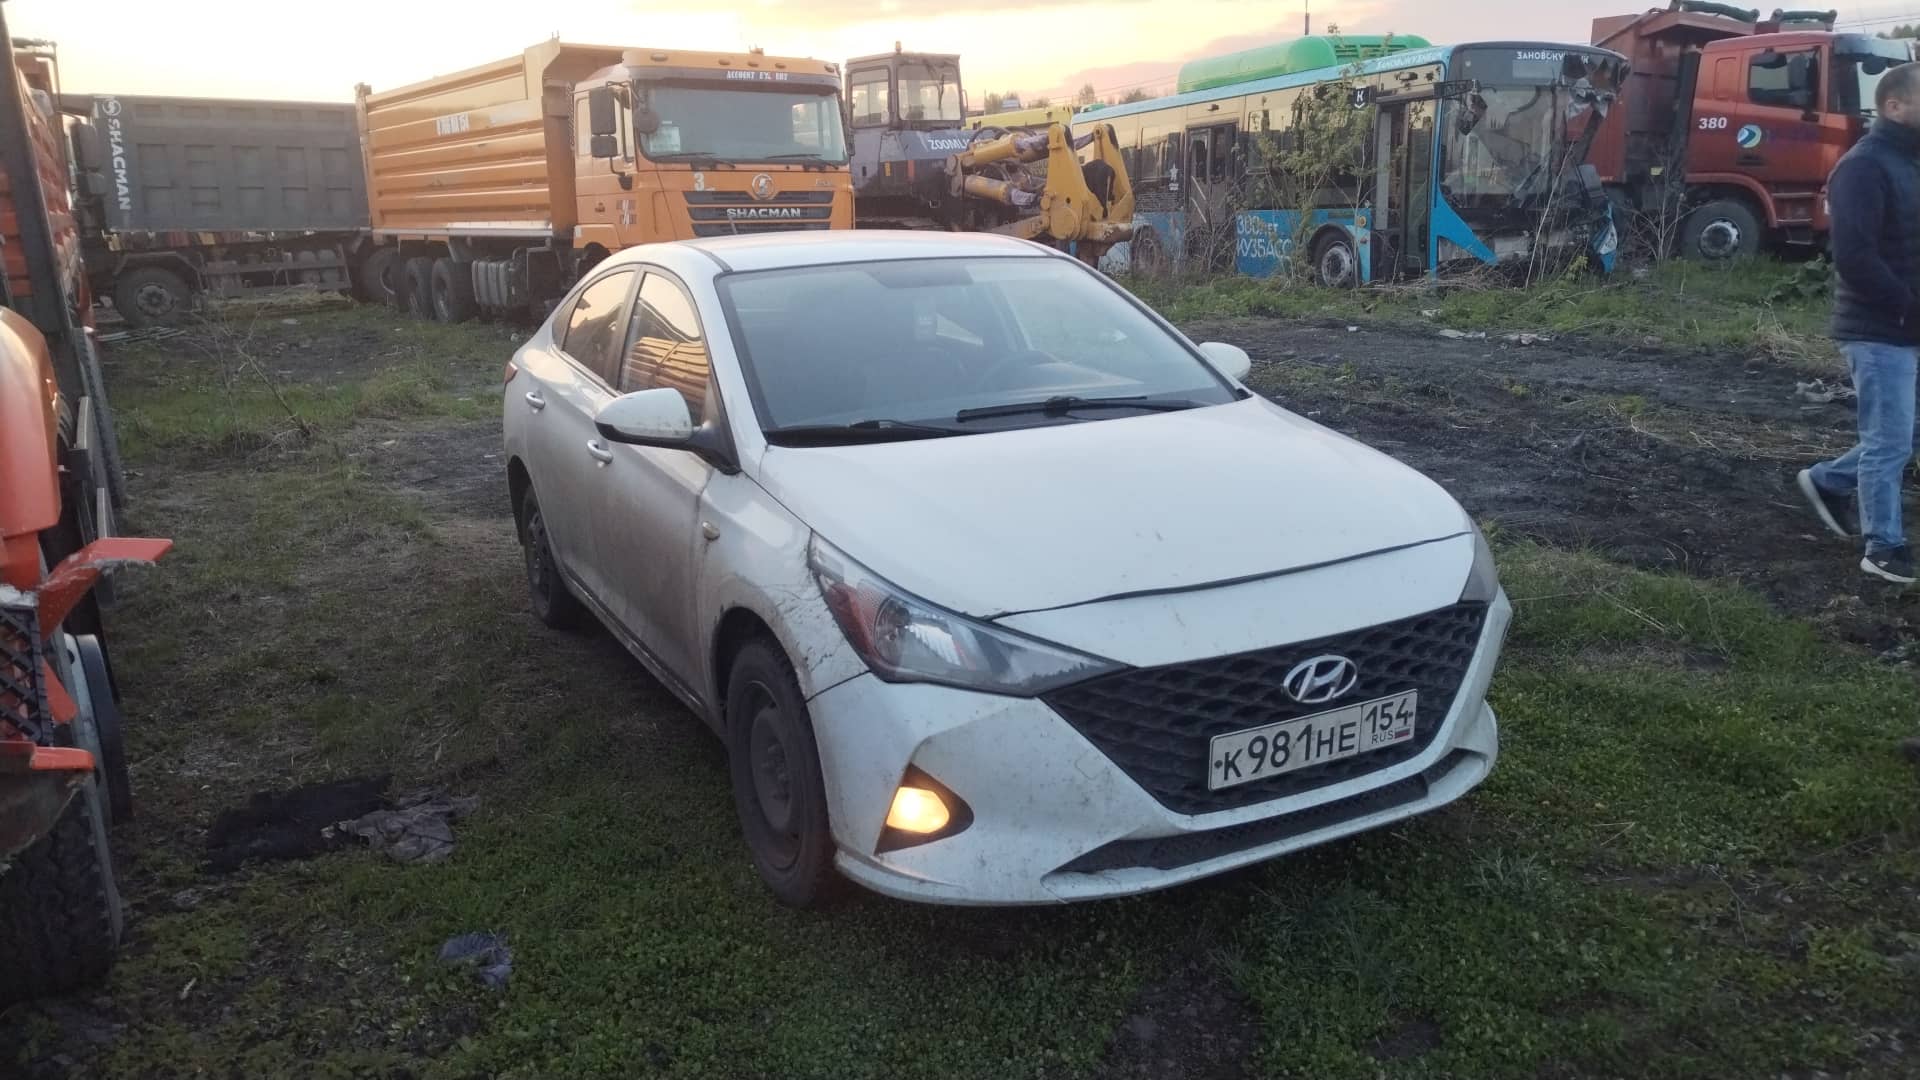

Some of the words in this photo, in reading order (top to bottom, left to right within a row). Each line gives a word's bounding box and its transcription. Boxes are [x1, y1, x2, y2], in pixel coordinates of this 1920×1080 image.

[1698, 117, 1728, 130] 380
[107, 118, 131, 210] SHACMAN
[727, 207, 801, 218] SHACMAN
[1223, 721, 1357, 781] К981НЕ
[1364, 698, 1409, 734] 154
[1371, 729, 1394, 745] RUS
